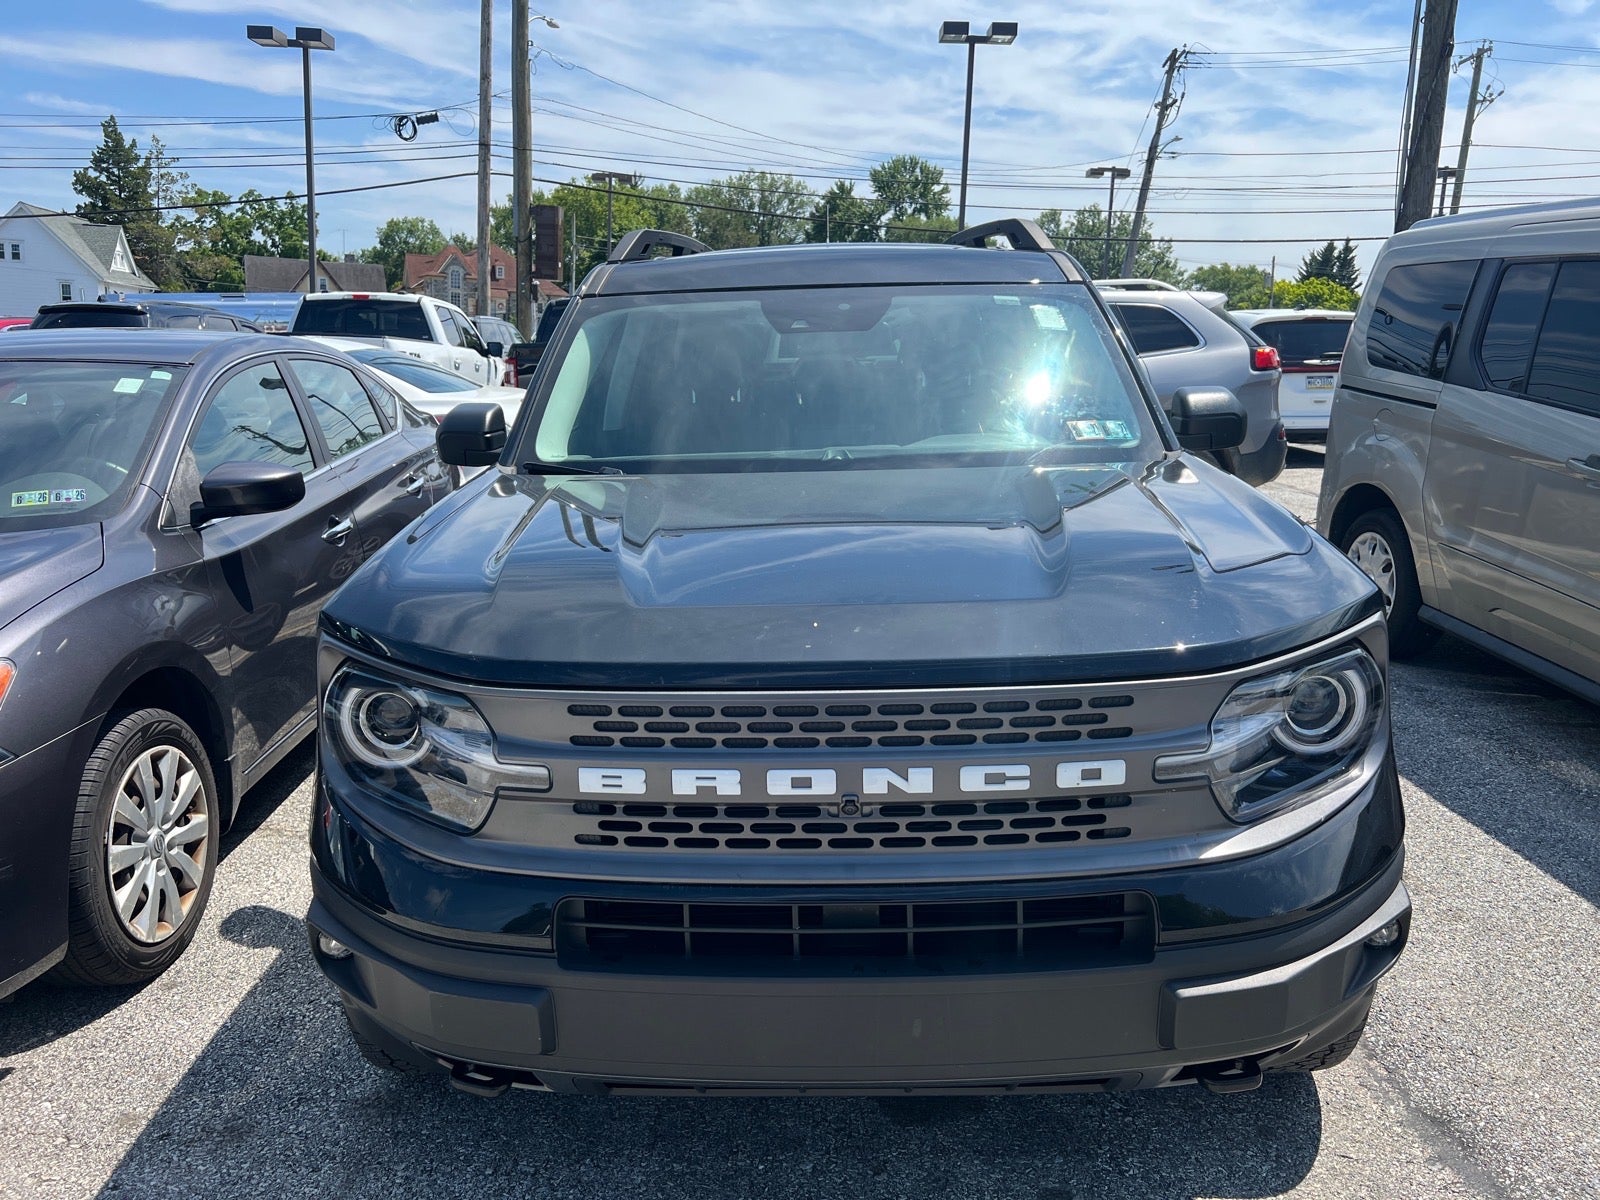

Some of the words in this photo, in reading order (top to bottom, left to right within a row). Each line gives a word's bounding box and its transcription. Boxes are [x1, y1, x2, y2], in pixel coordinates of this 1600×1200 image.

[16, 496, 22, 504] 6
[37, 492, 47, 502] 26
[55, 493, 61, 501] 6
[75, 489, 85, 500] 26
[577, 759, 1127, 796] BRONCO
